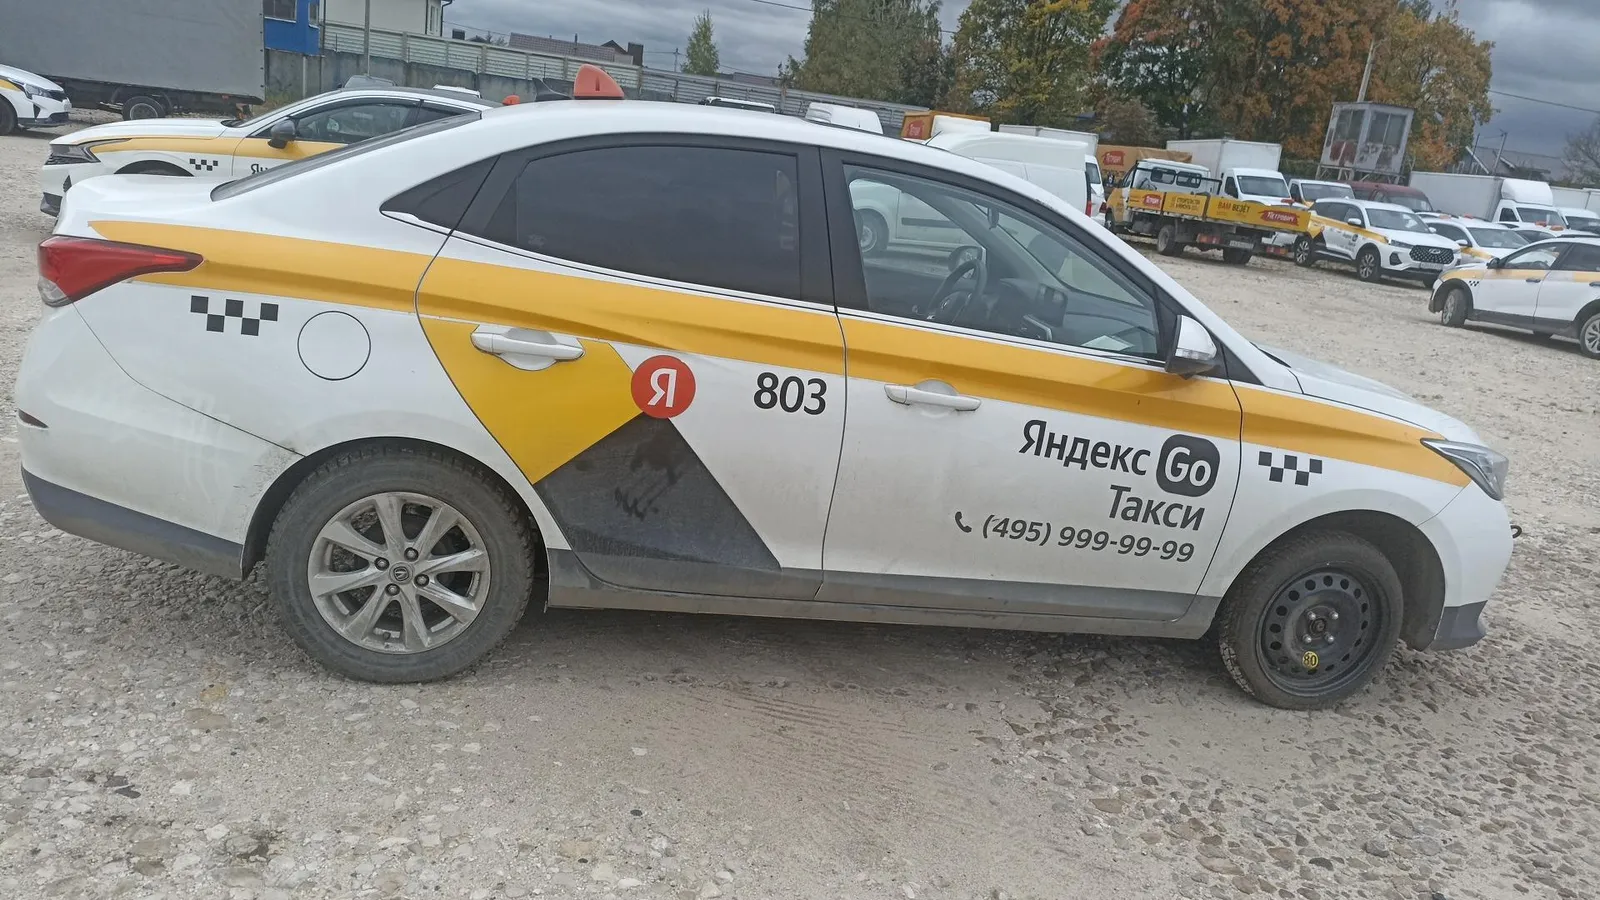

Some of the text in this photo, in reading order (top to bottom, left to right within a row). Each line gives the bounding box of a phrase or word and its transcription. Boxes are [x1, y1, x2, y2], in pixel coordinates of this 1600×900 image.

[647, 368, 678, 408] Я
[753, 371, 828, 416] 803
[1019, 419, 1212, 487] Яндекс Go
[1108, 484, 1205, 531] Такси
[982, 514, 1195, 563] (495) 999-99-99
[1304, 654, 1317, 666] 80
